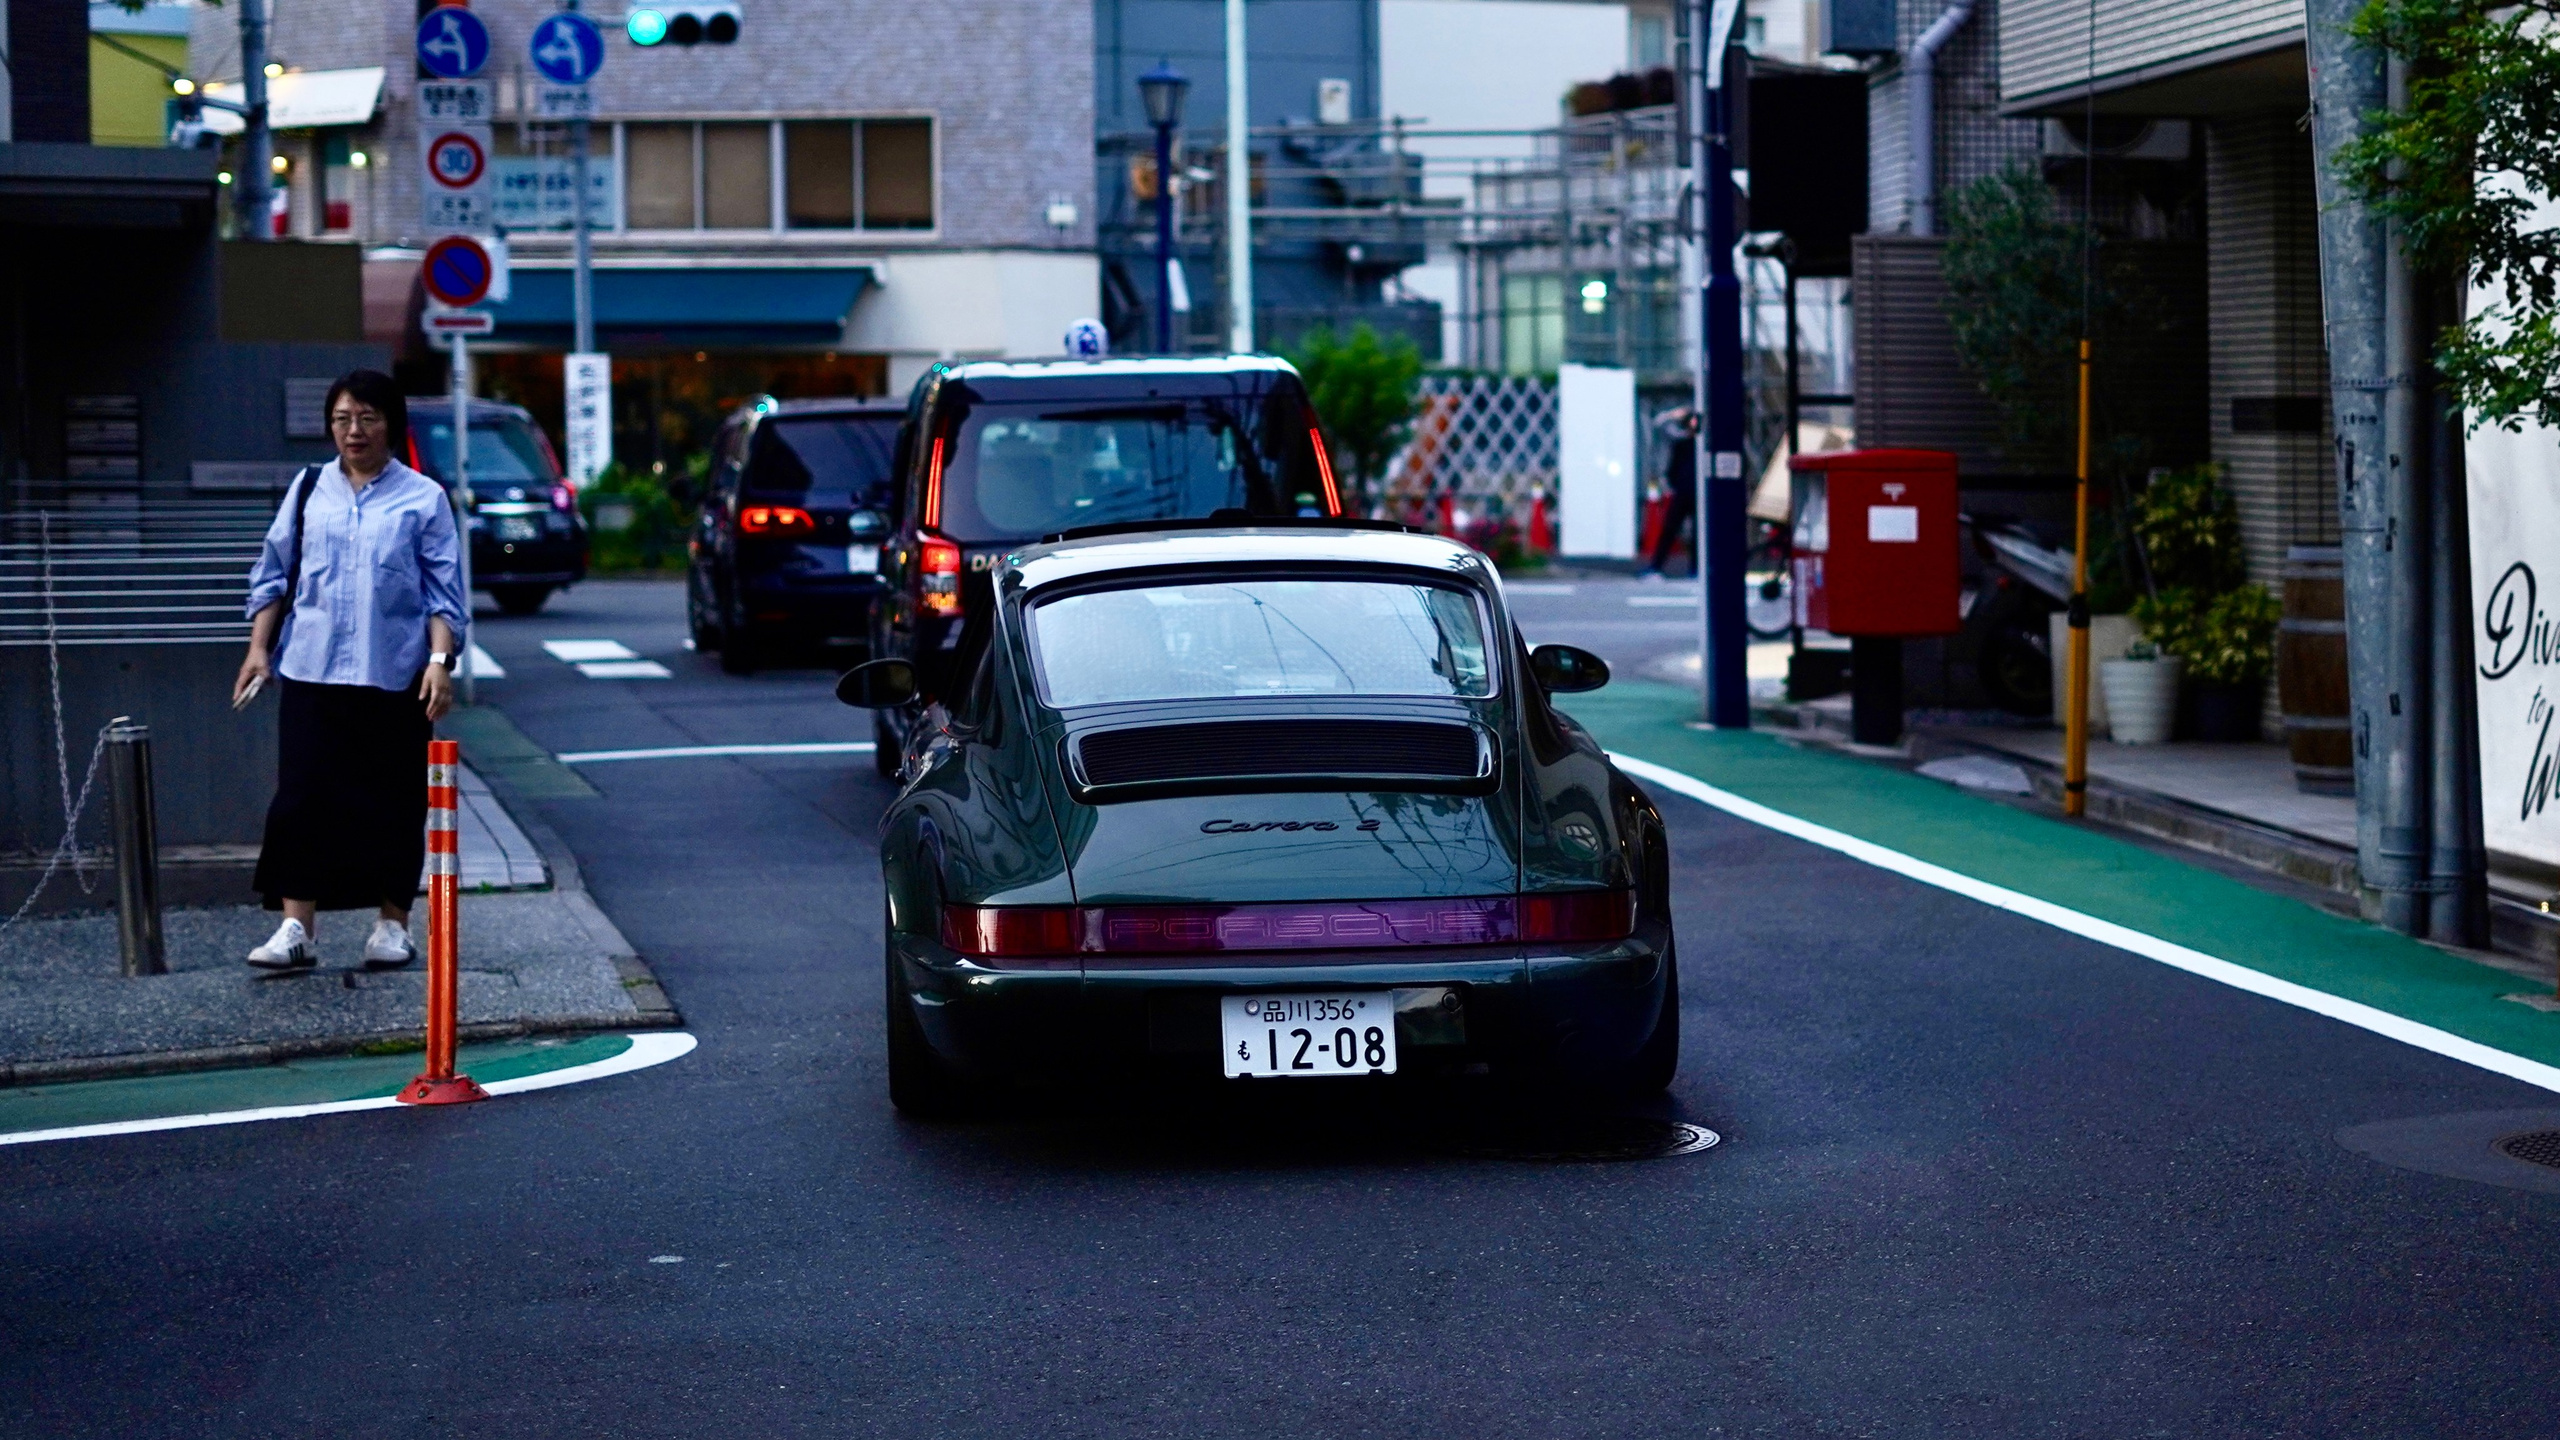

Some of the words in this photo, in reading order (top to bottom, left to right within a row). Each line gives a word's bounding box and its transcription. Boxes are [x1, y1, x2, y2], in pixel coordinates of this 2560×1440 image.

[441, 147, 475, 174] 30
[2526, 684, 2547, 725] to
[1200, 819, 1340, 834] Carrera
[1356, 819, 1380, 832] 2
[1109, 909, 1490, 941] PORSCHE
[1237, 1040, 1251, 1061] も
[1268, 1026, 1386, 1071] 12-08
